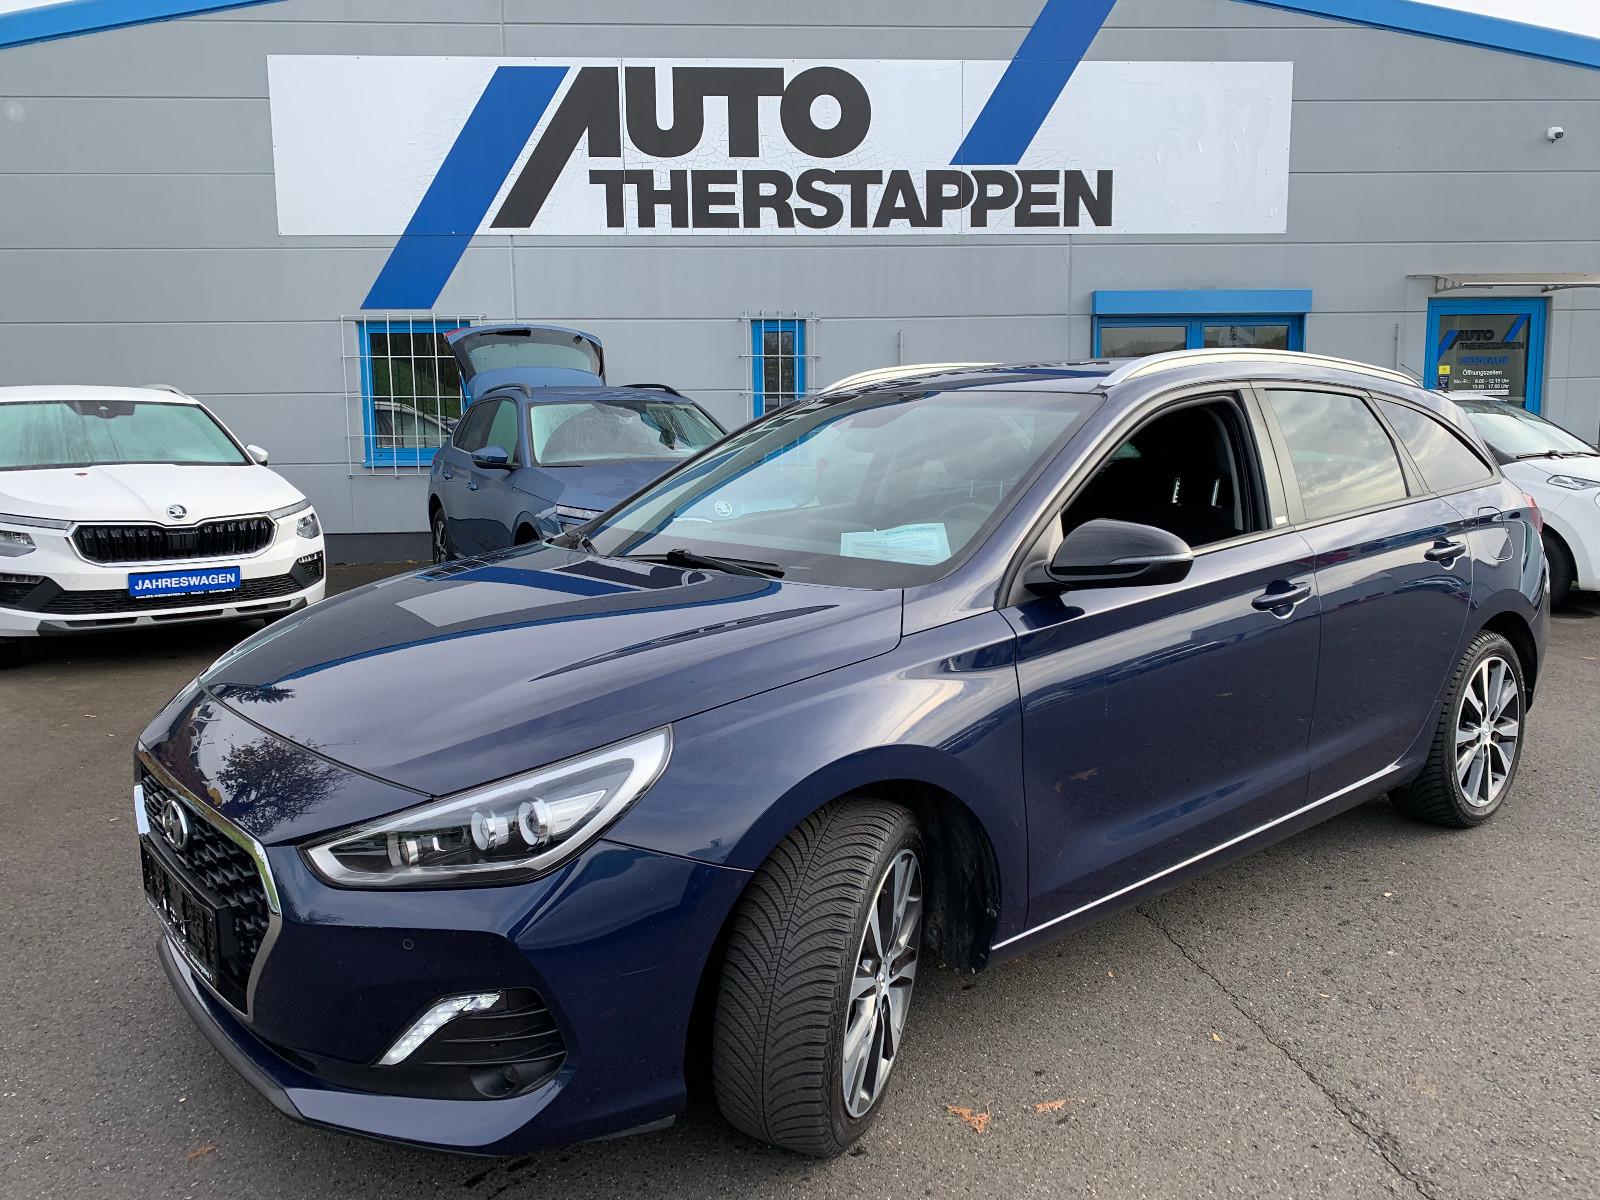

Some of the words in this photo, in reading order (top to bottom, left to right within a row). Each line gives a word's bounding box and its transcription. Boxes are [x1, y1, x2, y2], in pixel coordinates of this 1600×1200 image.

[490, 66, 872, 229] AUTO
[589, 168, 1113, 229] THERSTAPPEN
[1448, 329, 1495, 349] AUTO
[134, 573, 236, 590] JAHRESWAGEN
